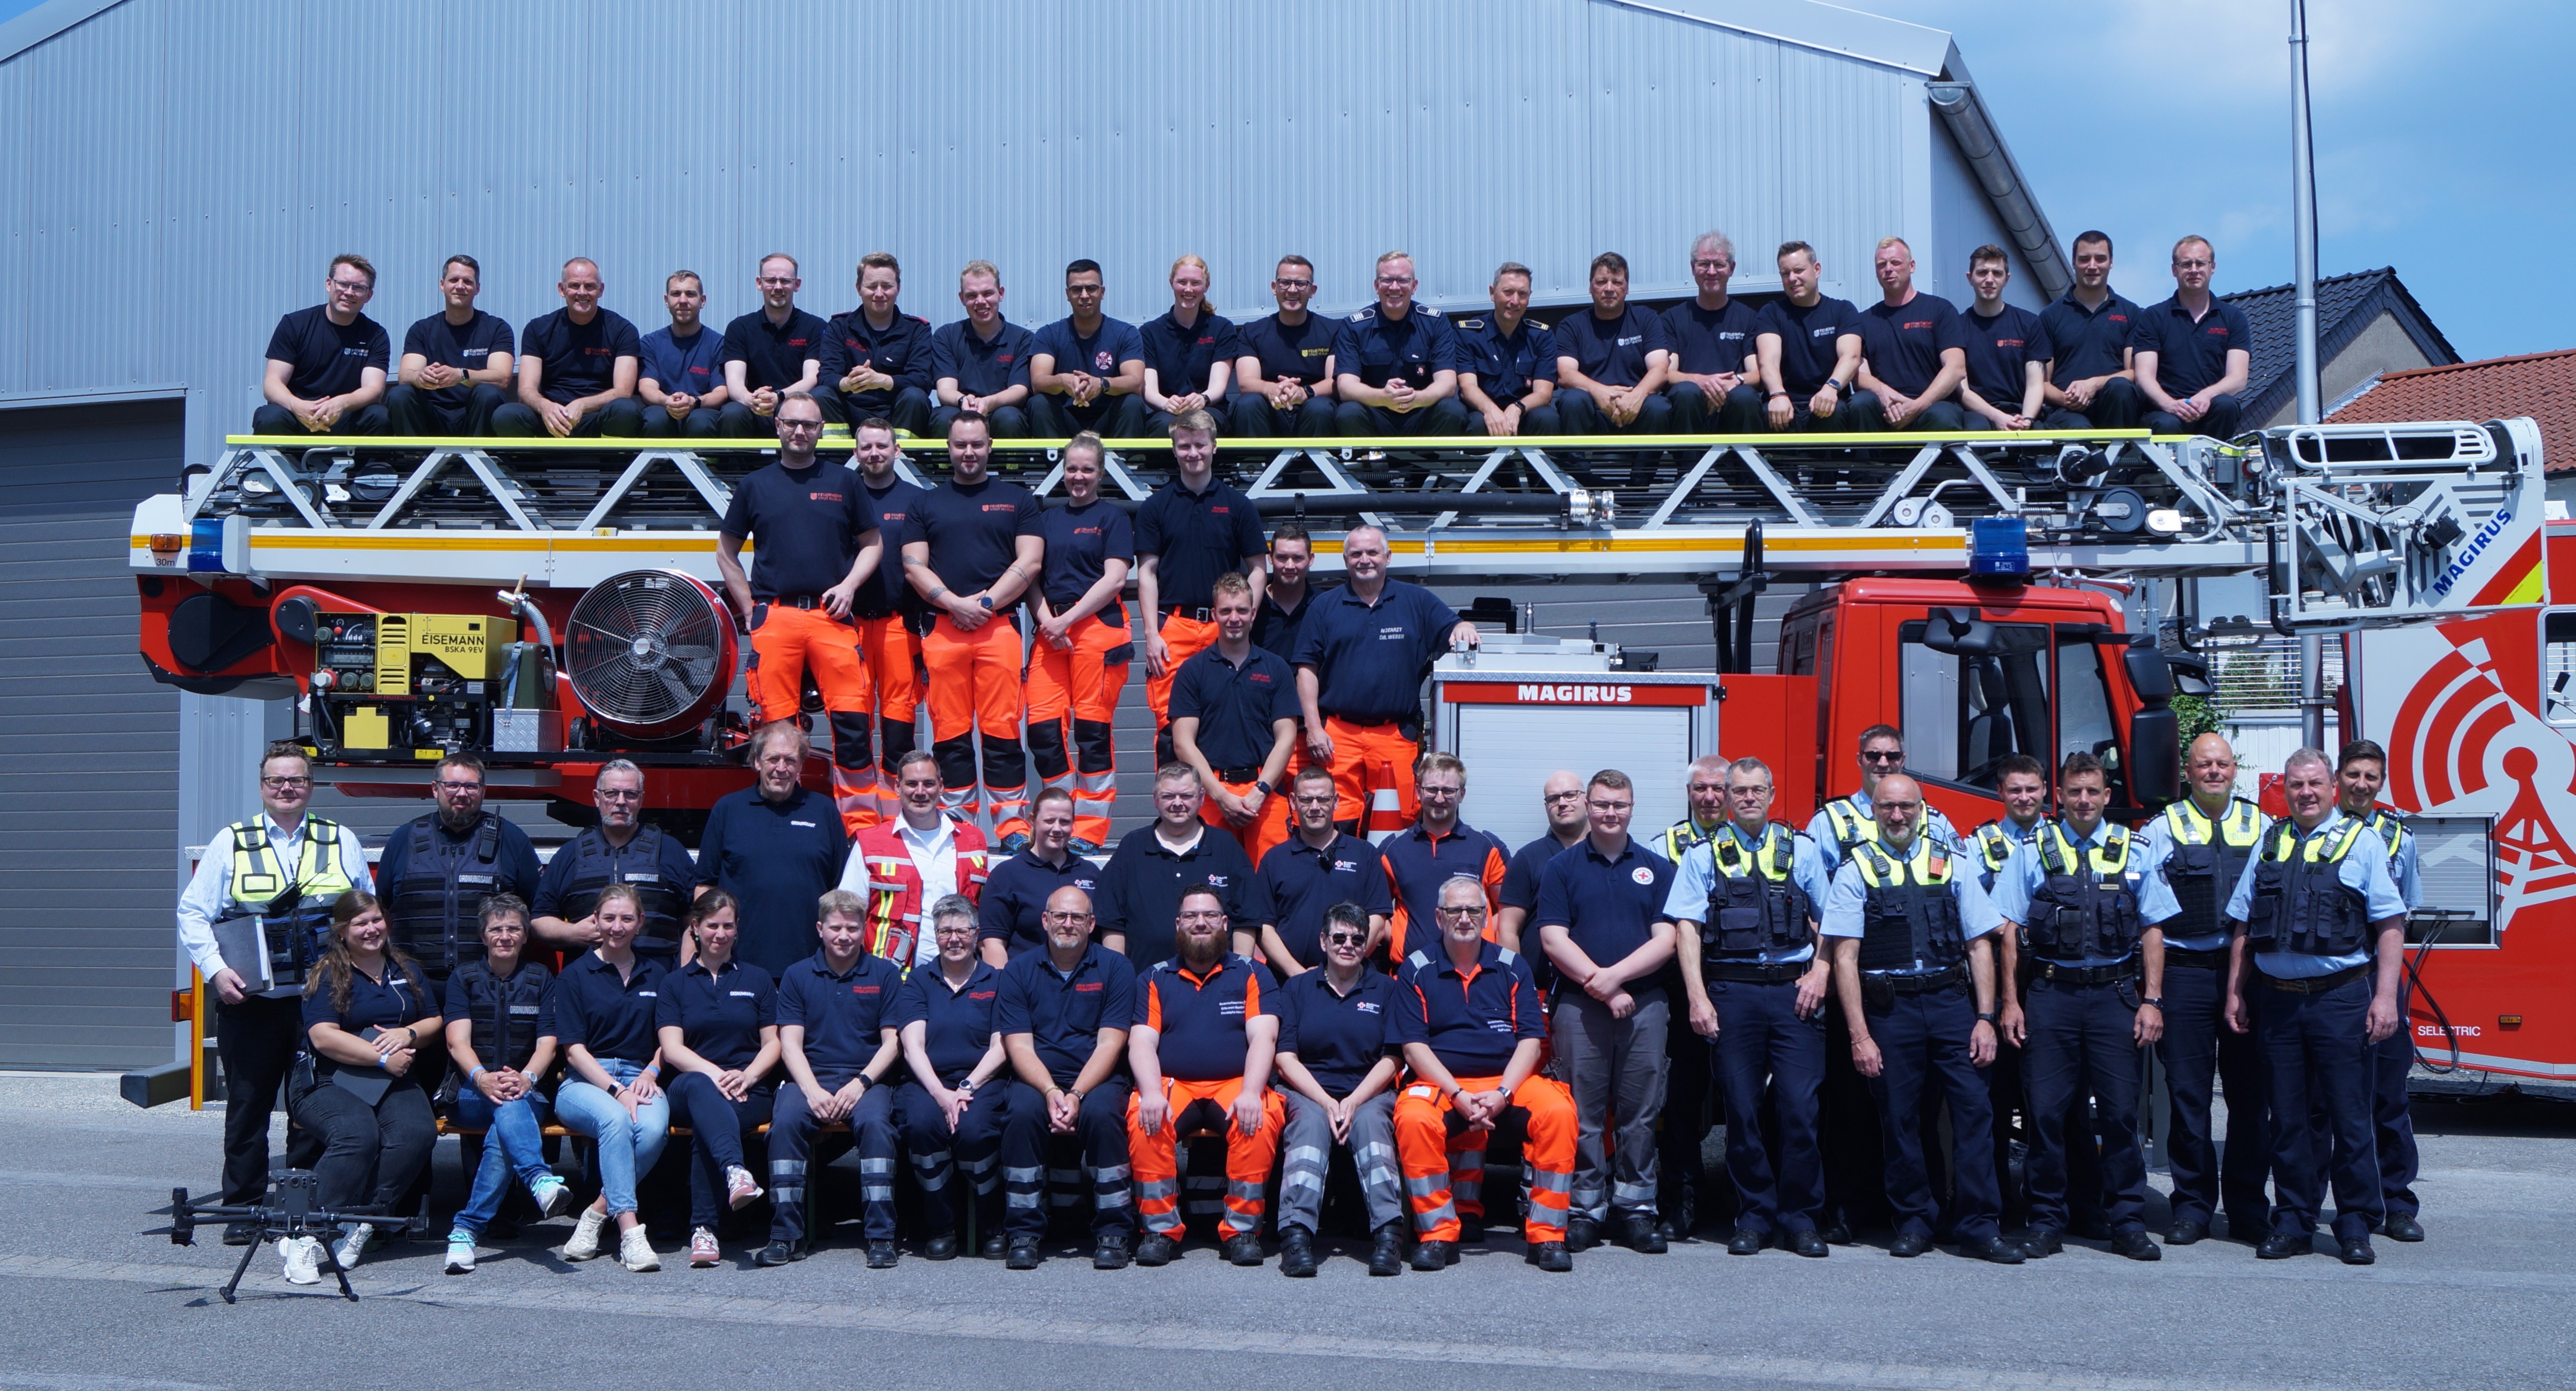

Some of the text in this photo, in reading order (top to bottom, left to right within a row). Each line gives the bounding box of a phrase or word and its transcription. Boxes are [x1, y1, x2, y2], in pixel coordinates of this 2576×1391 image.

[2432, 508, 2511, 596] MAGIRUS
[157, 558, 175, 567] 30m
[422, 635, 484, 645] EISEMANN
[1518, 685, 1632, 702] MAGIRUS
[459, 875, 493, 884] ORDNUNGSAMT
[625, 873, 658, 882] ORDNUNGSAMT
[510, 1005, 540, 1014] ORDNUNGSA
